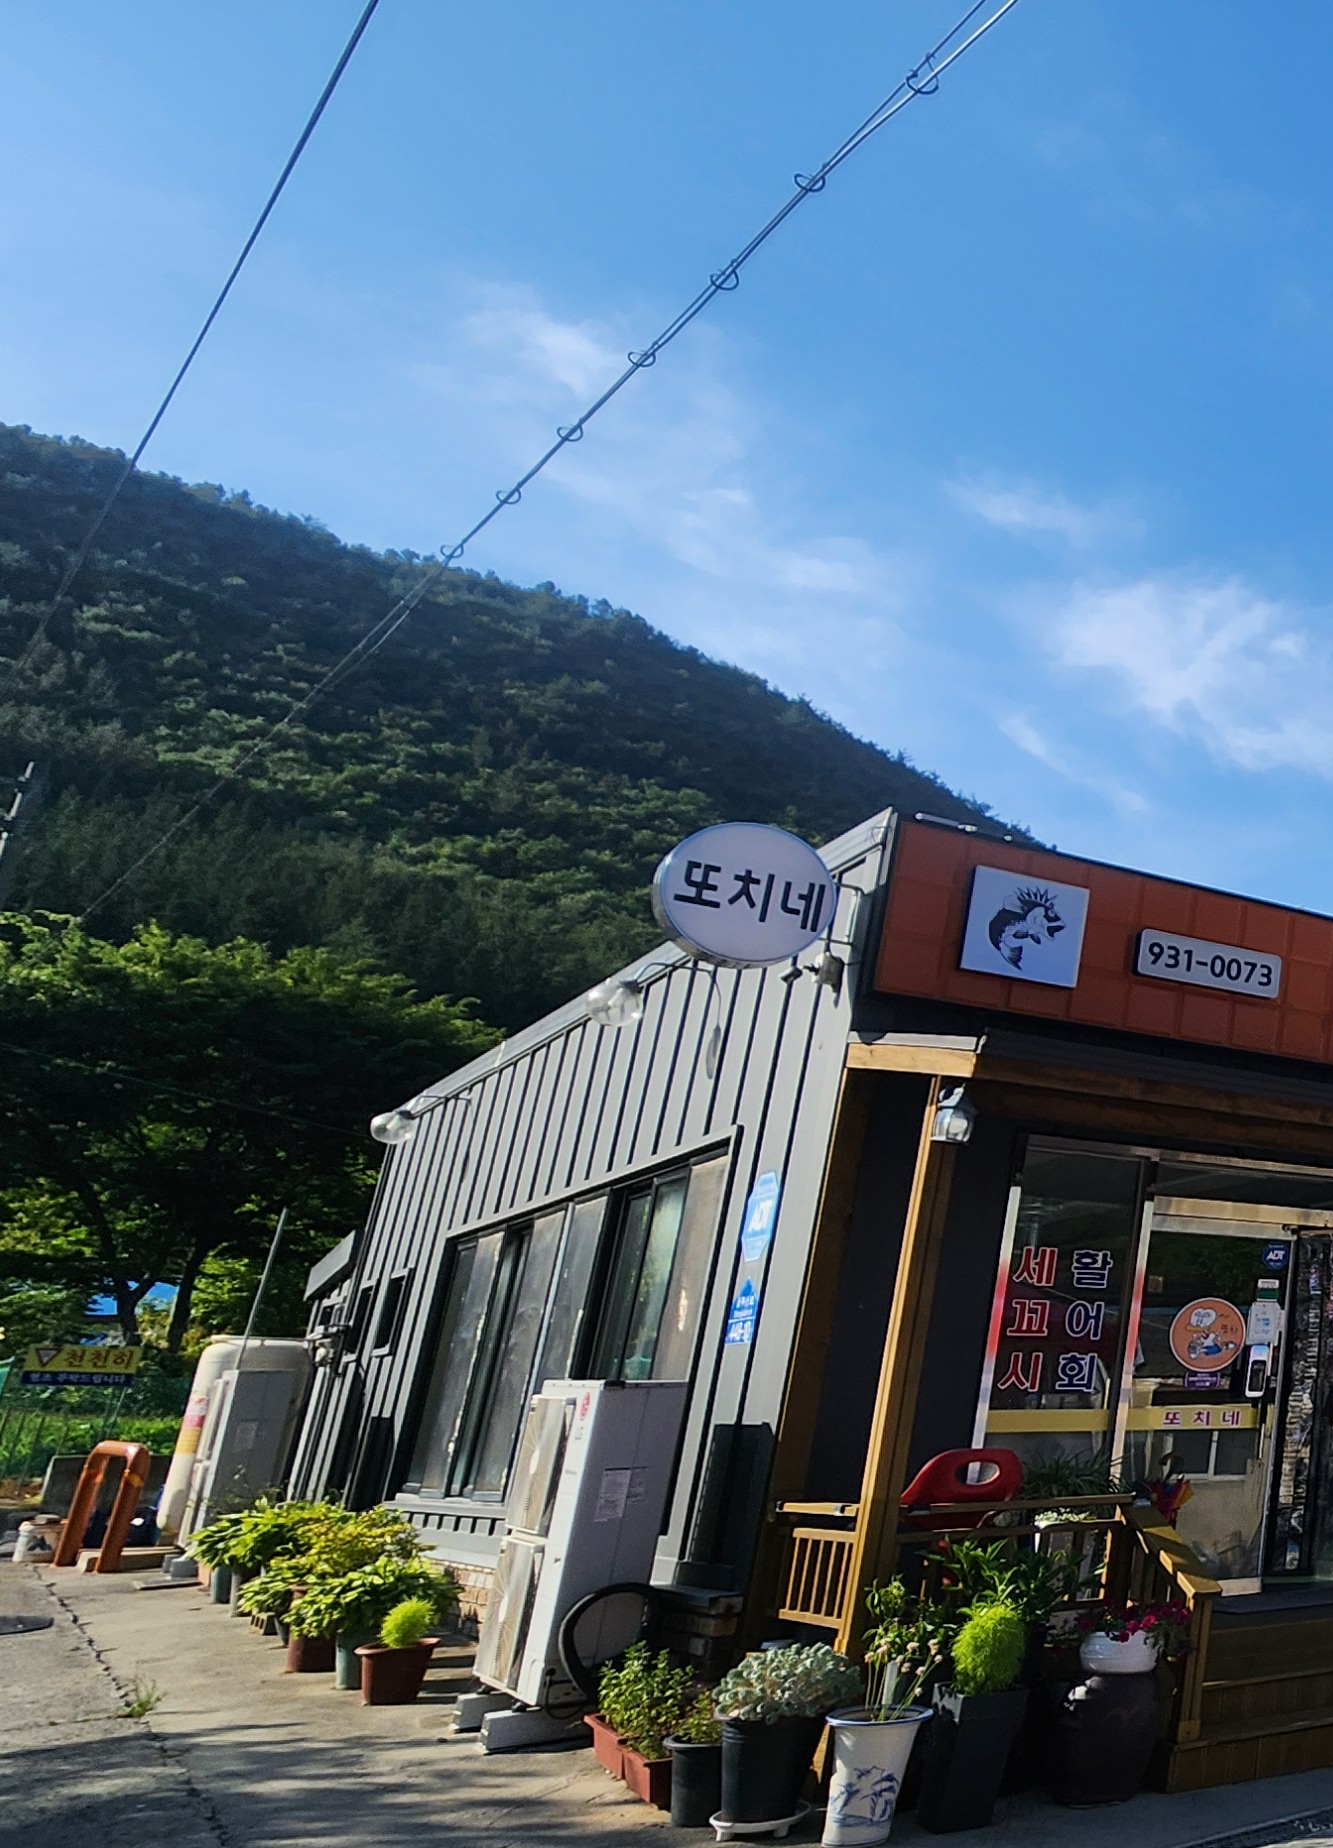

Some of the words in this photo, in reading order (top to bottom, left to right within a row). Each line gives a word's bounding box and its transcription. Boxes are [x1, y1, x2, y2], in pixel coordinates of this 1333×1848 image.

[673, 859, 827, 933] 또치네
[1147, 941, 1274, 989] 931-0073
[1265, 1249, 1286, 1261] ADT
[996, 1245, 1059, 1393] 세꼬시
[1054, 1248, 1114, 1393] 활어회
[64, 1347, 135, 1370] 천천히
[1162, 1409, 1241, 1427] 또치네
